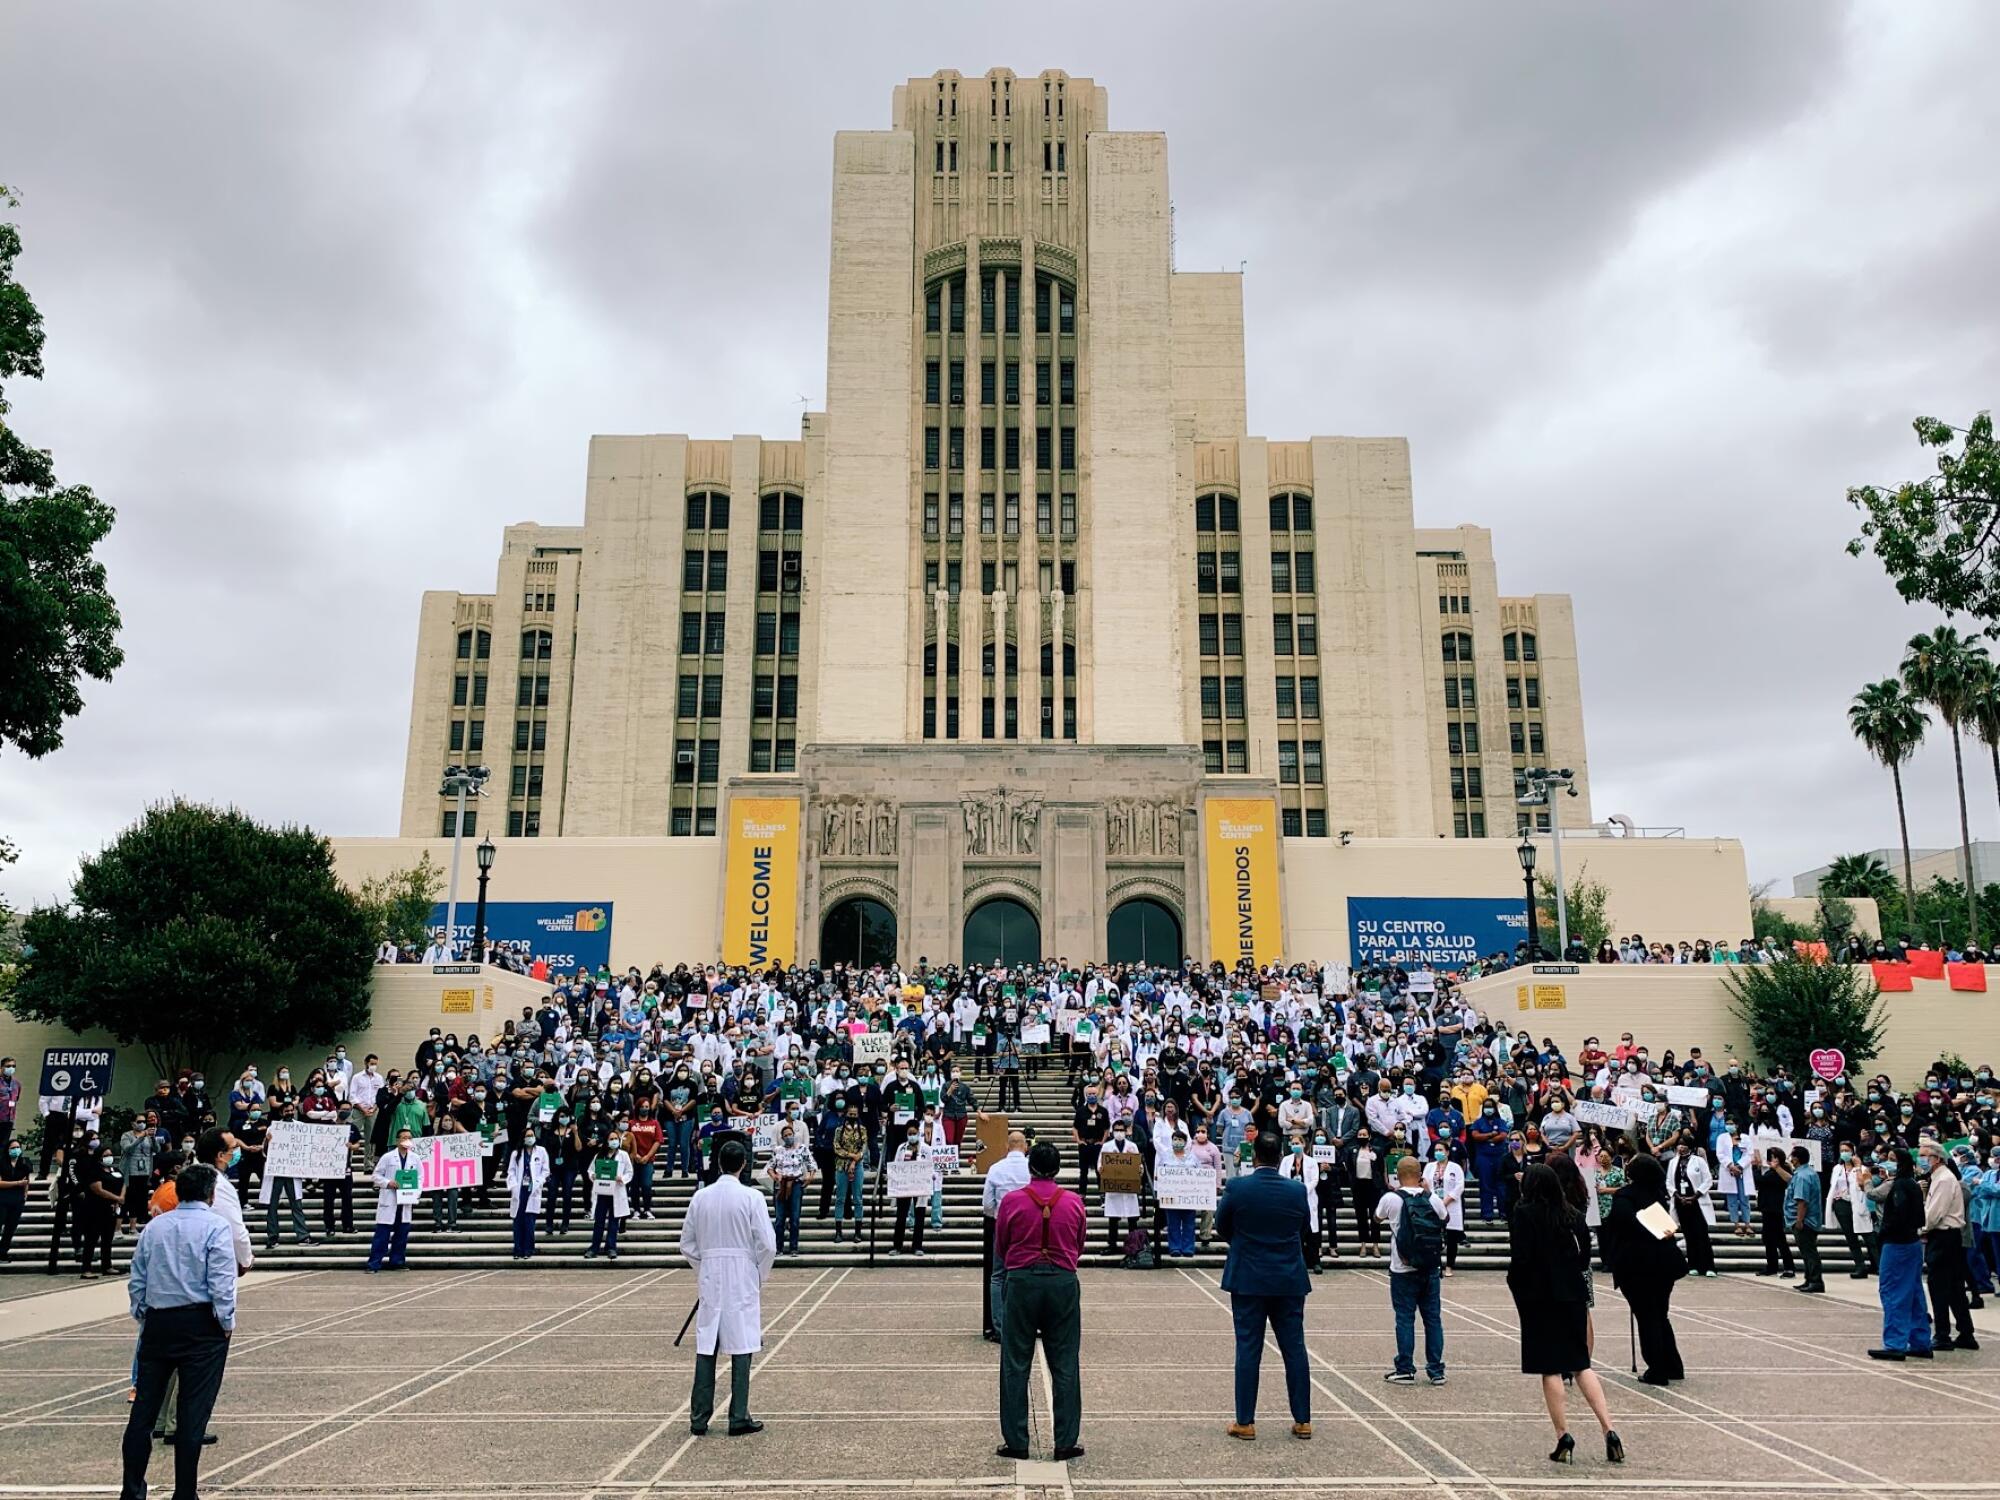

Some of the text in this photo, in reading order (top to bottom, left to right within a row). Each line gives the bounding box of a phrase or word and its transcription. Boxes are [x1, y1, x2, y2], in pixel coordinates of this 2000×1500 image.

[749, 846, 772, 967] WELCOME
[1235, 846, 1254, 968] BIENVENIDOS
[1357, 920, 1446, 933] SU CENTRO
[1359, 935, 1476, 948] PARA LA SALUD
[1358, 949, 1369, 961] Y
[1395, 949, 1478, 963] BIENESTAR
[46, 1052, 109, 1066] ELEVATOR
[730, 1114, 776, 1128] JUSTICE
[442, 1134, 474, 1145] PUBLIC
[449, 1143, 477, 1153] HEALTH
[454, 1149, 482, 1159] CRISIS
[931, 1146, 956, 1156] MAKE
